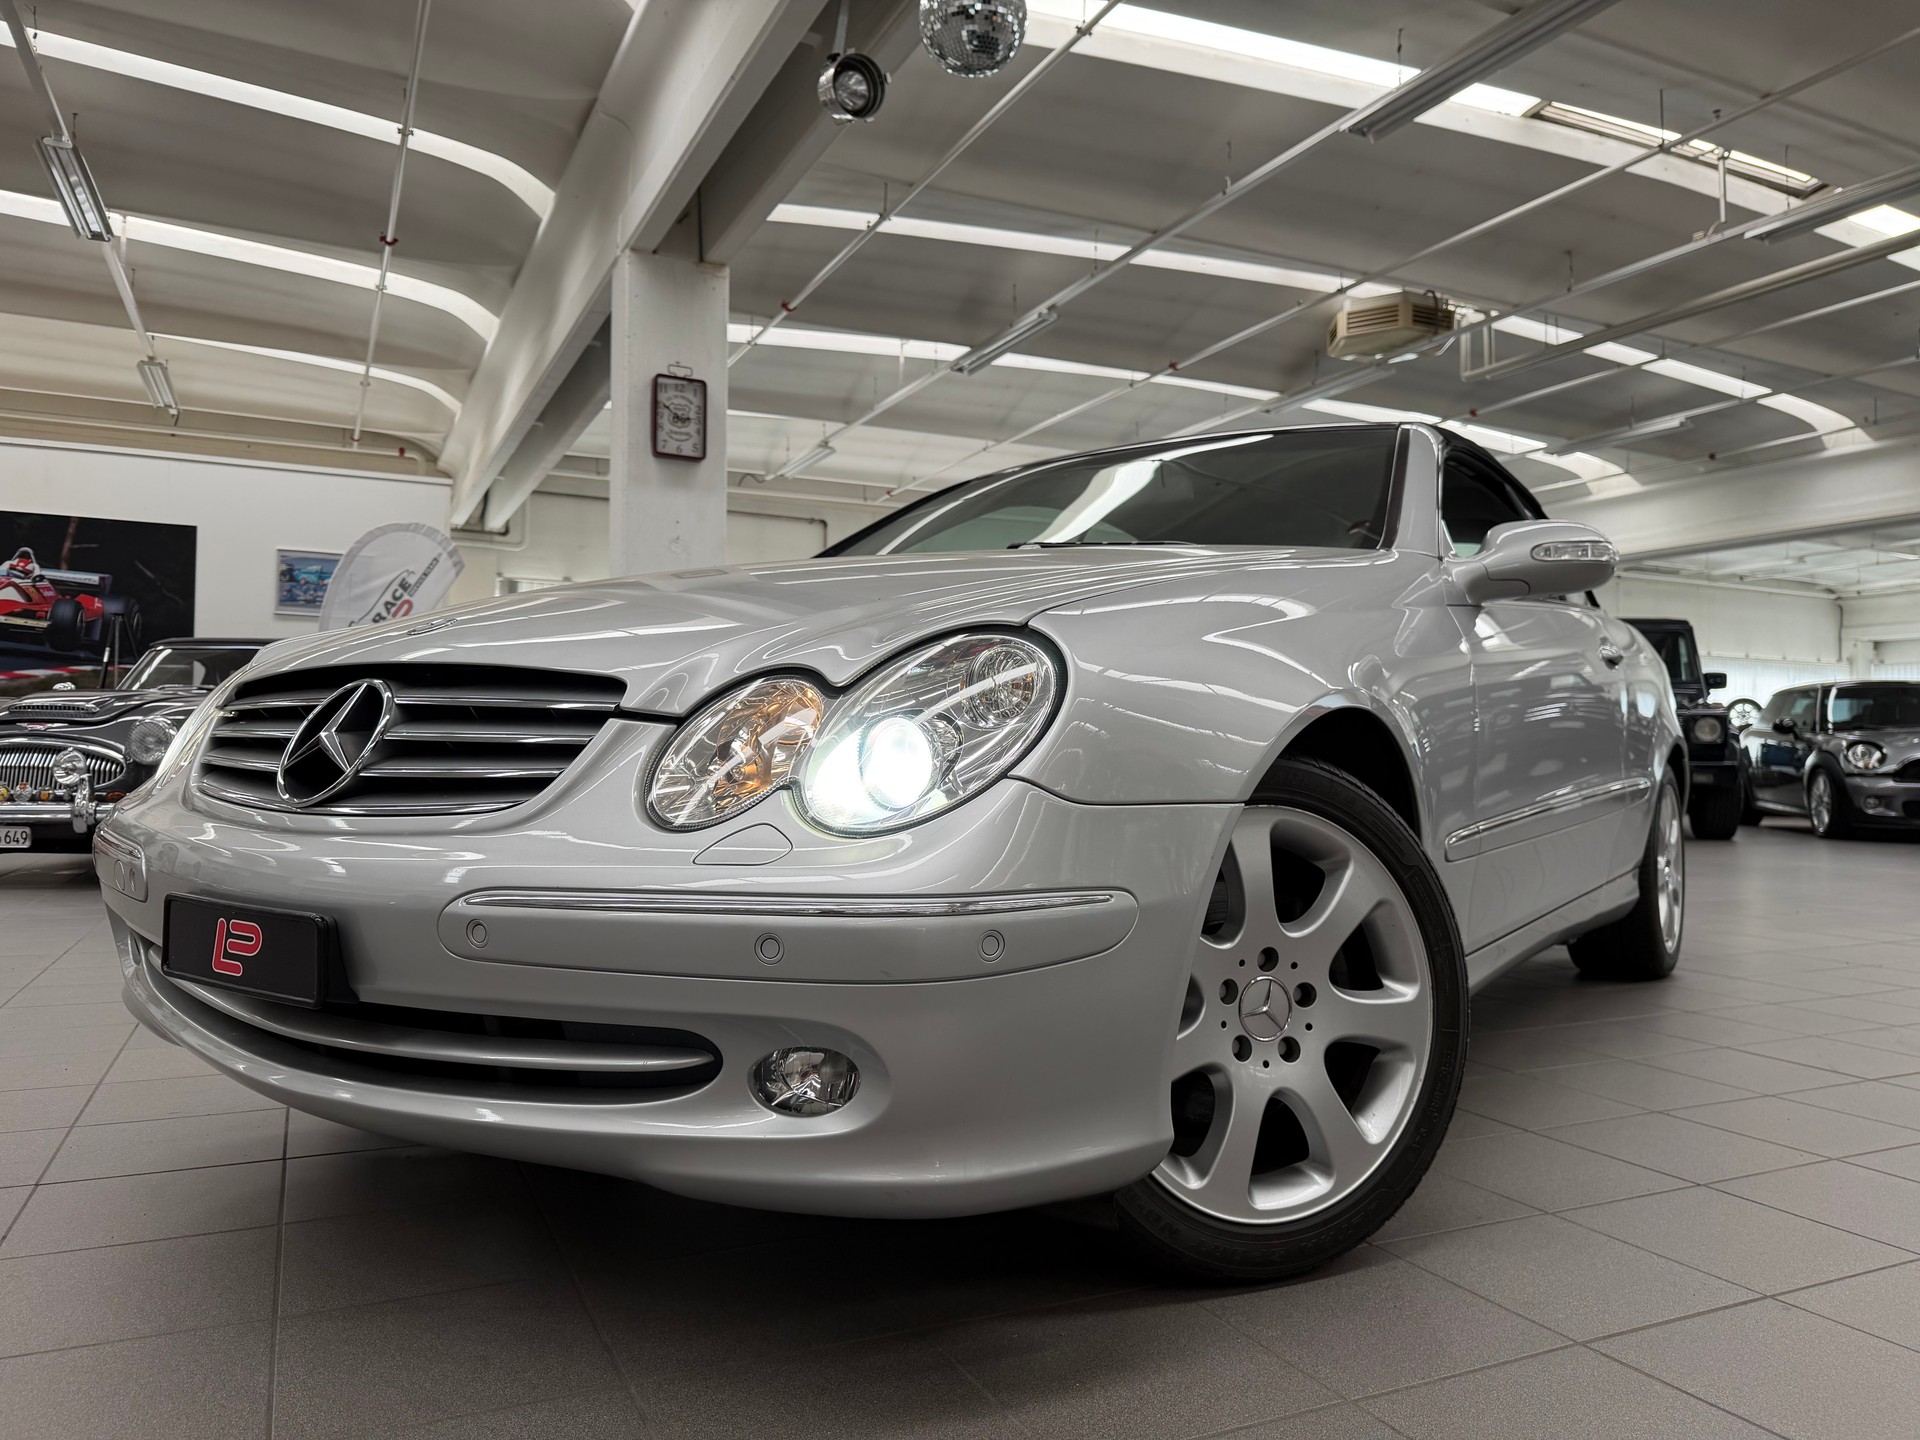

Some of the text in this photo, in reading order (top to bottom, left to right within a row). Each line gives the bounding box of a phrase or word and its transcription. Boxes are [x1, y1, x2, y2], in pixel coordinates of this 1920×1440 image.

[675, 383, 686, 394] 12
[661, 439, 668, 450] 7
[676, 444, 684, 454] 6
[692, 442, 700, 454] 5
[4, 830, 28, 845] 649
